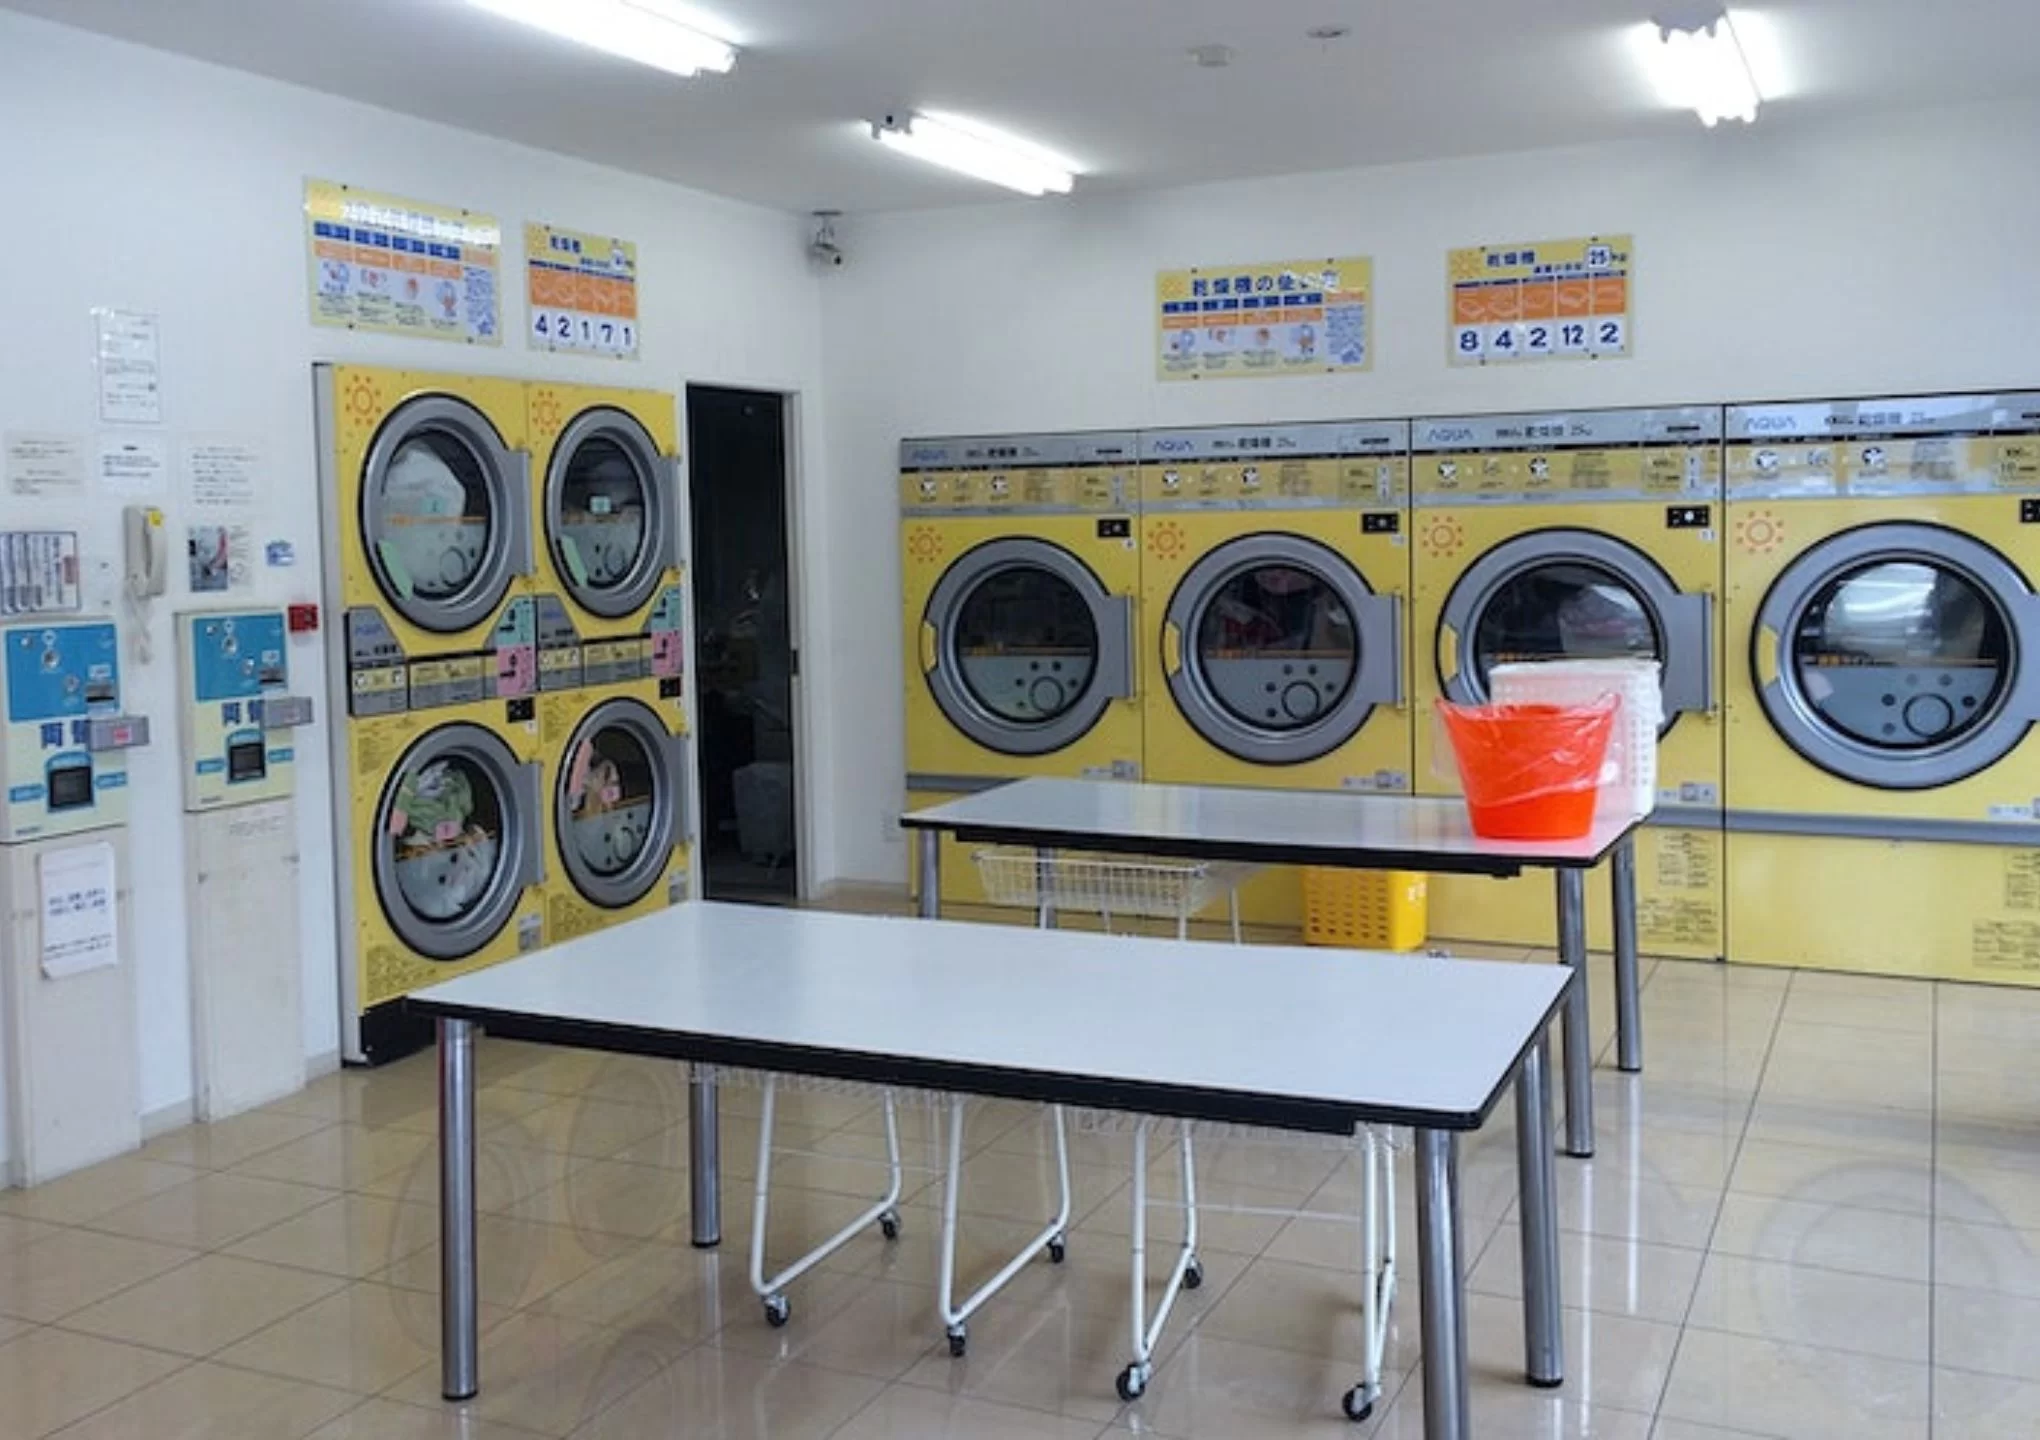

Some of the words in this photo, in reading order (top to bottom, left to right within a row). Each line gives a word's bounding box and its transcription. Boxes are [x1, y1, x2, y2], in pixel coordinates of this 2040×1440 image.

[535, 313, 548, 335] 4
[557, 315, 571, 338] 2
[581, 320, 590, 340] 1
[600, 323, 614, 344] 7
[1460, 330, 1480, 351] 8
[1494, 328, 1513, 350] 4
[1529, 326, 1548, 348] 2
[1562, 324, 1585, 346] 12
[1599, 321, 1620, 344] 2
[1744, 416, 1797, 431] AQUA
[1427, 428, 1473, 442] AQUA
